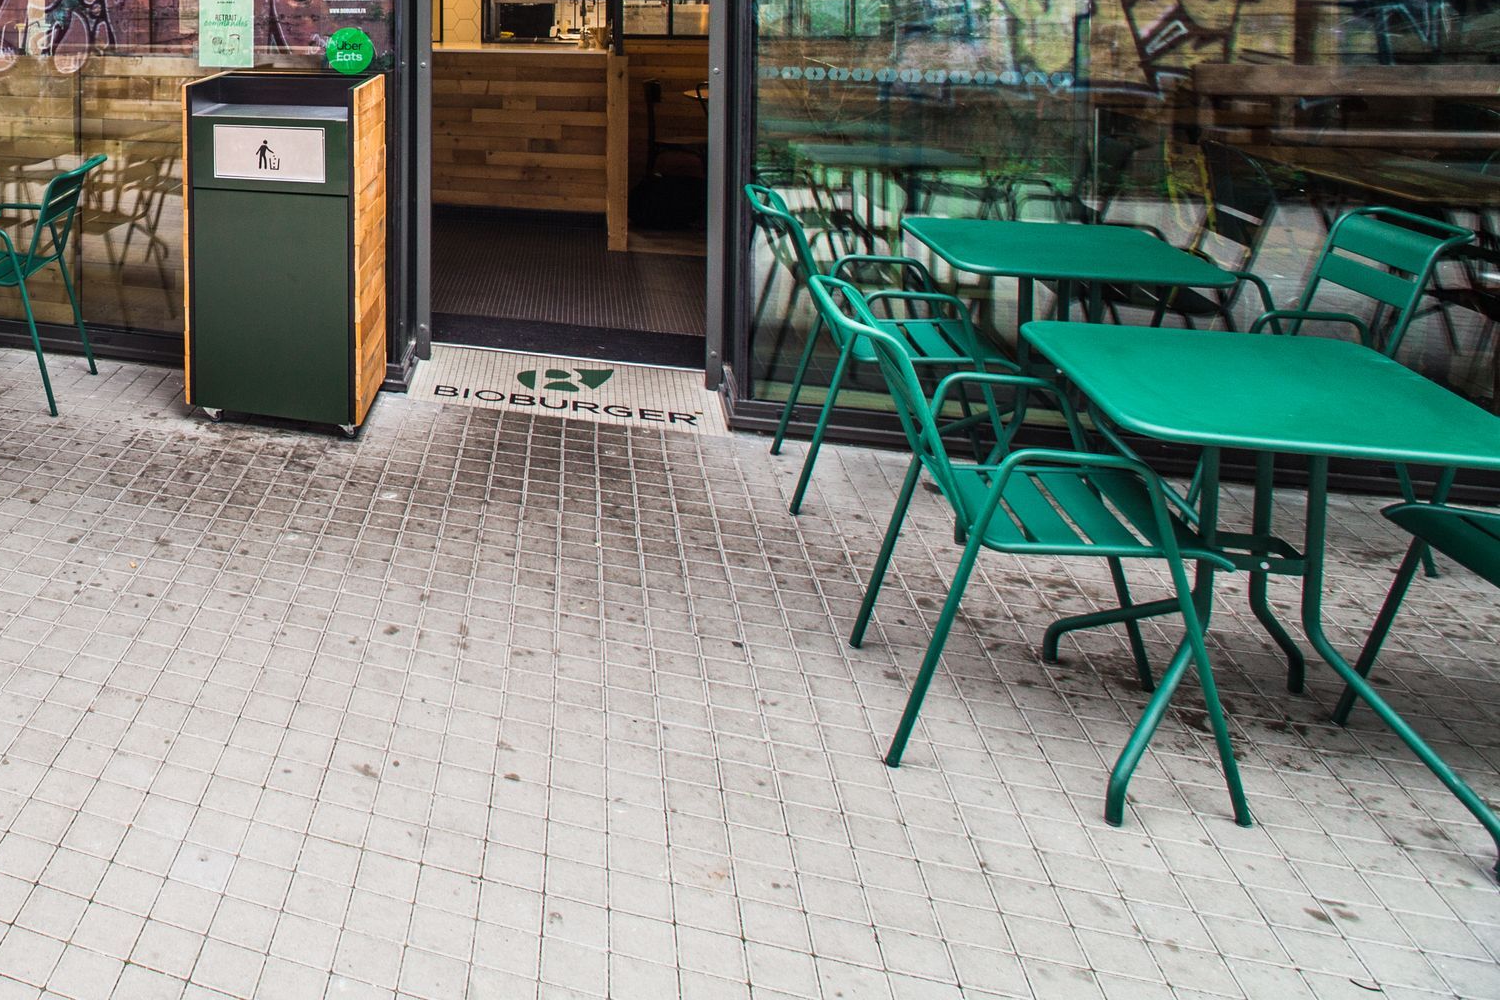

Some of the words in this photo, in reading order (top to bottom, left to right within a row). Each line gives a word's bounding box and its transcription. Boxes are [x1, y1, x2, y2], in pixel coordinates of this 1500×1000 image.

[336, 40, 362, 51] Uber
[336, 52, 363, 62] Eats
[433, 385, 699, 426] BIOBURGER
